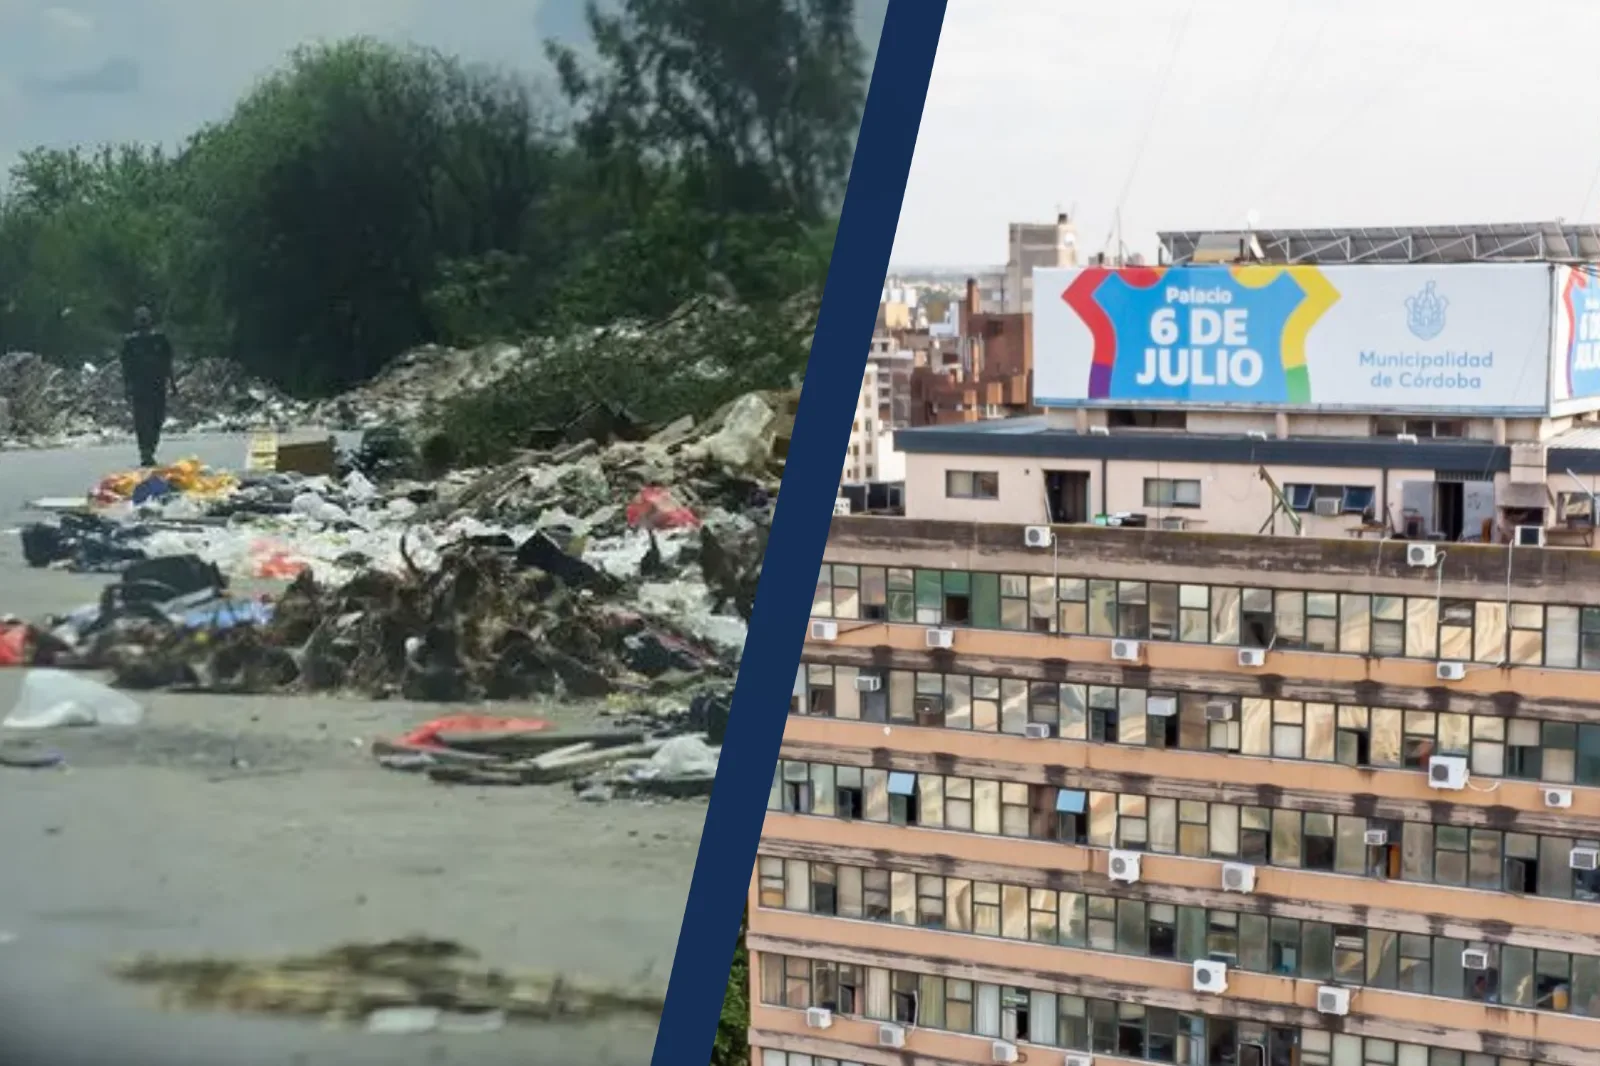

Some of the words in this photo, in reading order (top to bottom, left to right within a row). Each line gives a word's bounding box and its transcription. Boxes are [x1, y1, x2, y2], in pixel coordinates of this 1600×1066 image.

[1166, 286, 1233, 304] Palacio
[1150, 308, 1179, 346] 6
[1190, 308, 1248, 346] DE
[1136, 348, 1263, 387] JULIO
[1358, 350, 1493, 369] Municipalidad
[1370, 371, 1393, 388] de
[1399, 371, 1481, 388] Córdoba
